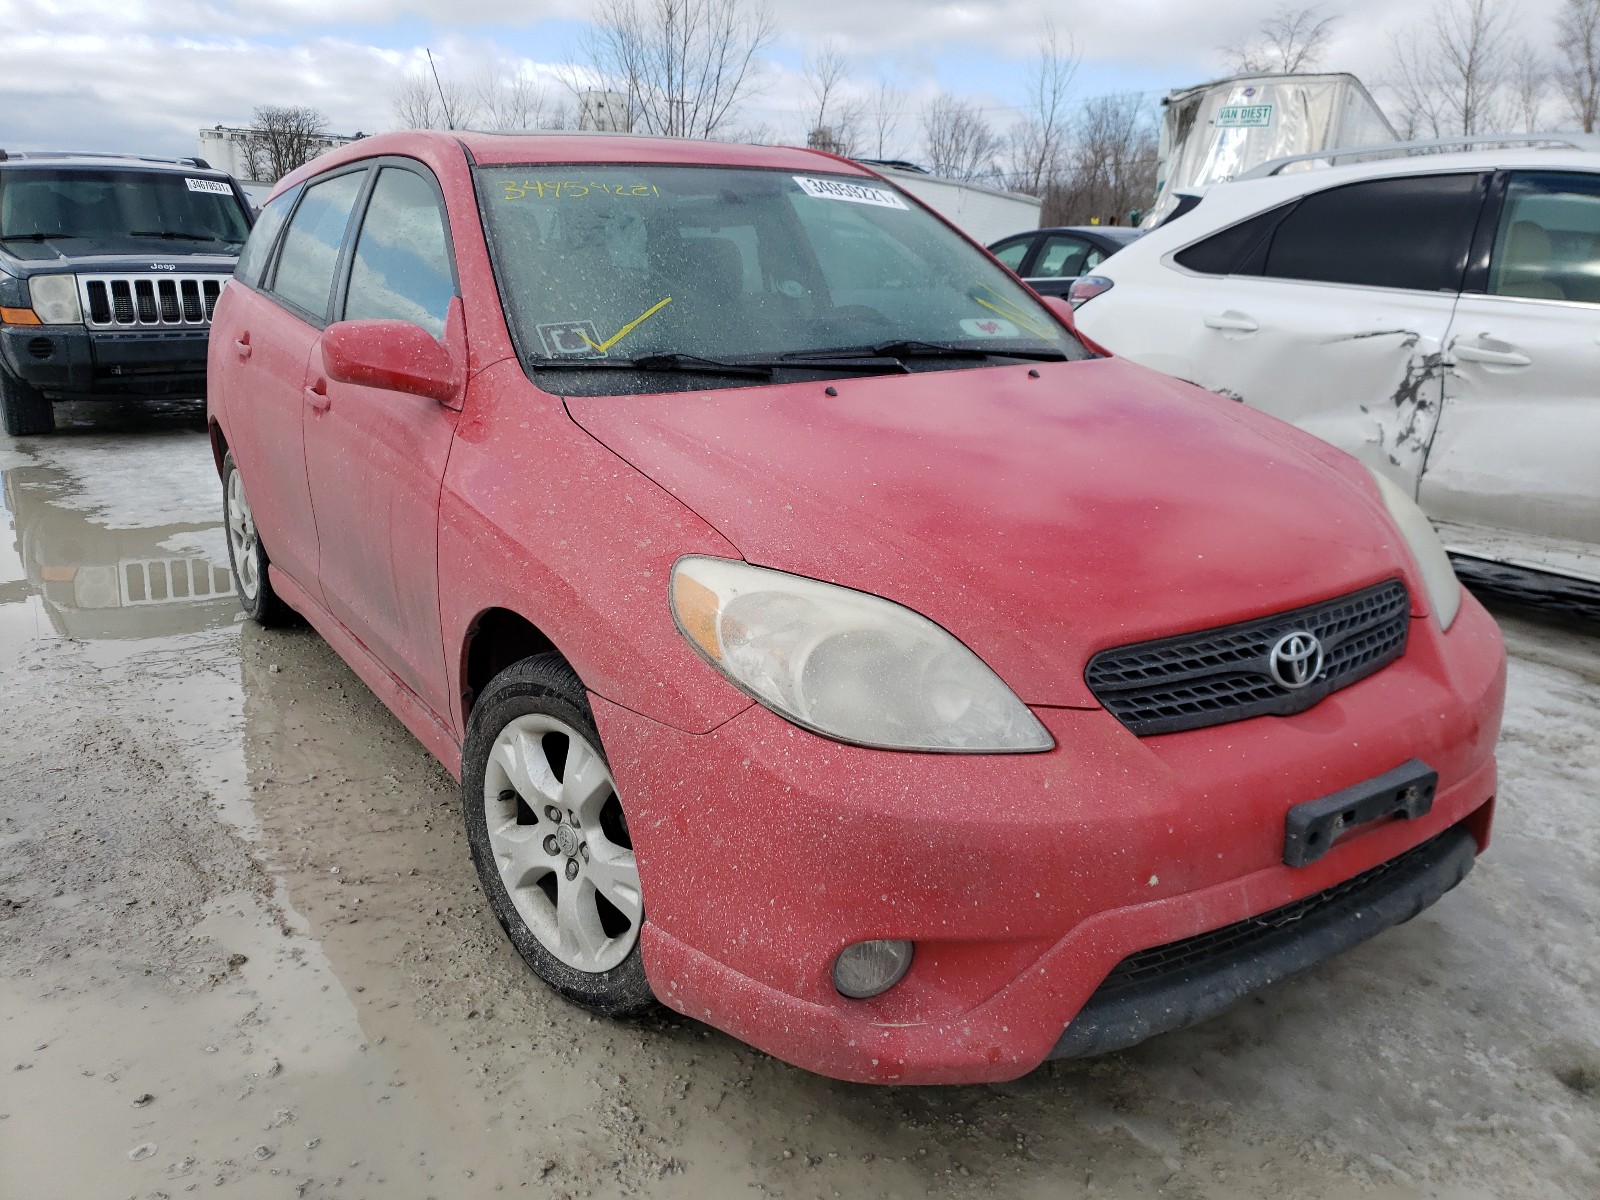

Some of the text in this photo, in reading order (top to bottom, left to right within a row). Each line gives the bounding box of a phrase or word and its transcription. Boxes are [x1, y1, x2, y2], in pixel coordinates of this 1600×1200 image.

[1220, 108, 1268, 119] VAN DIEST
[806, 178, 890, 204] 34959221
[150, 262, 176, 271] Jeep
